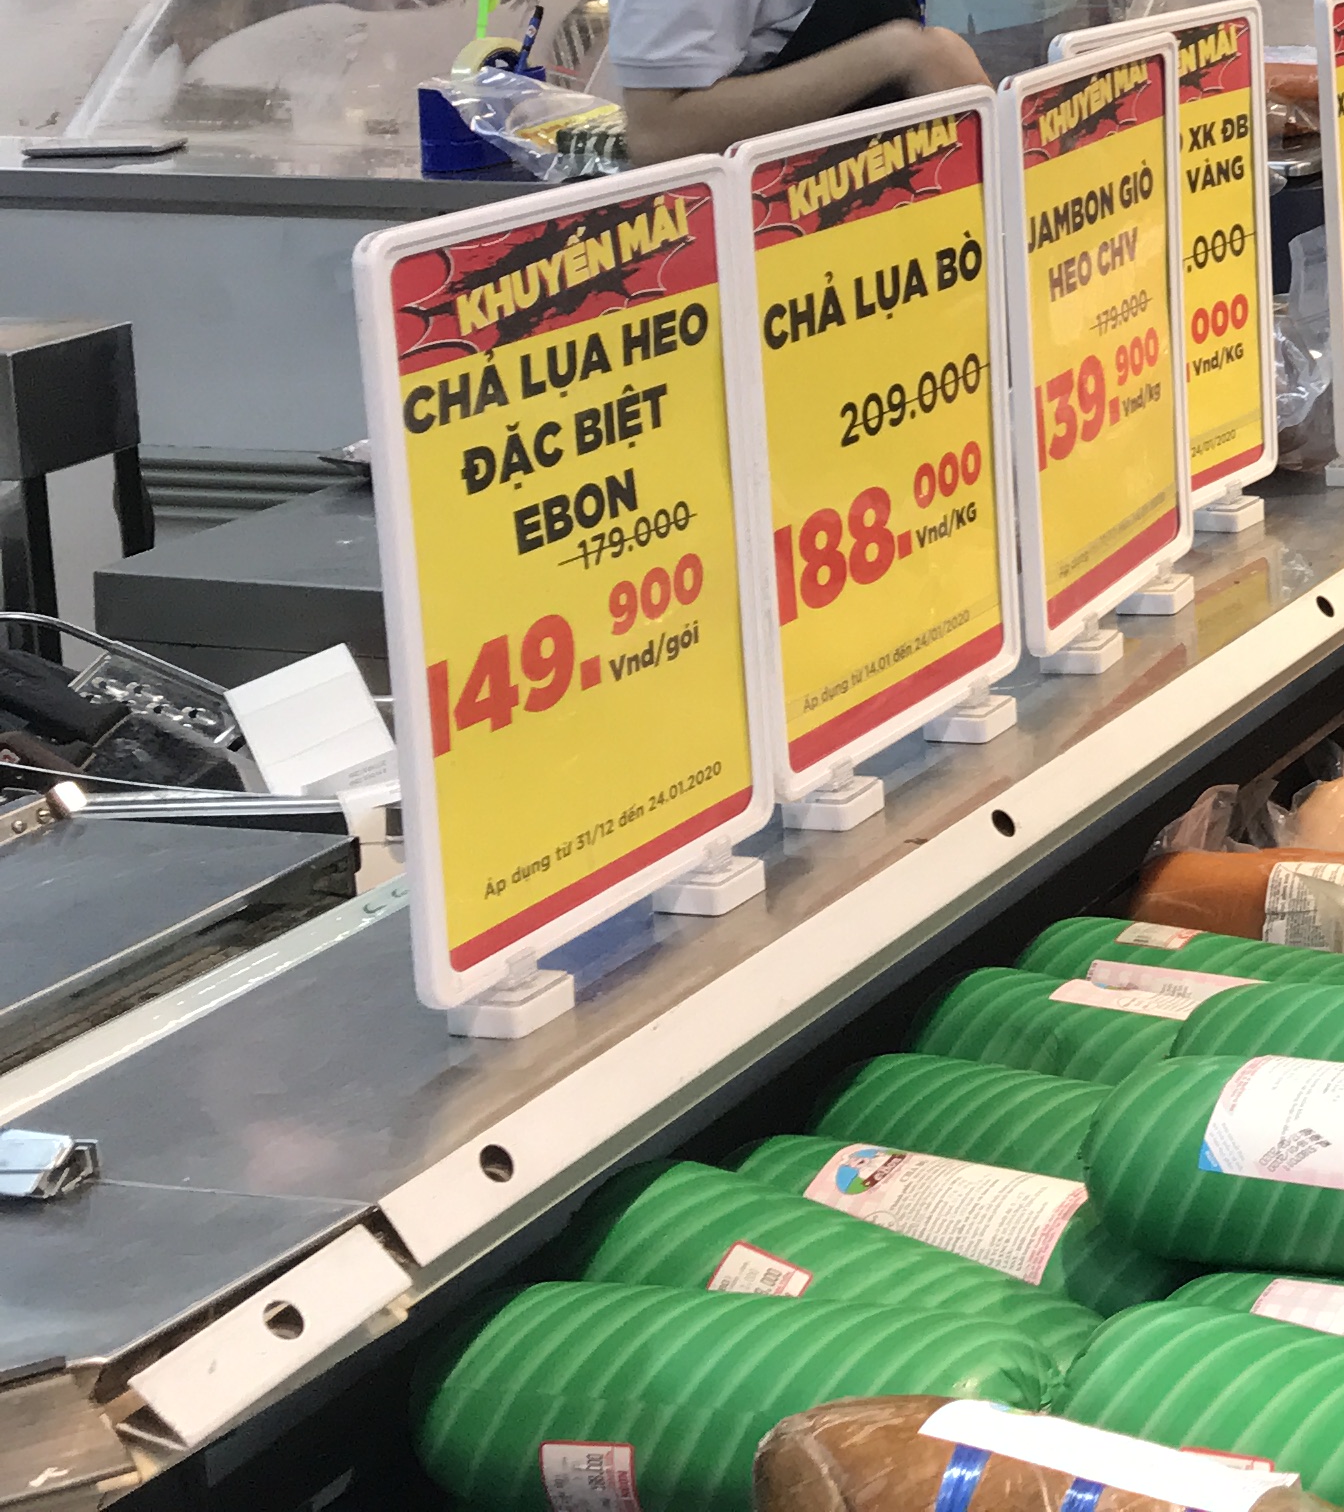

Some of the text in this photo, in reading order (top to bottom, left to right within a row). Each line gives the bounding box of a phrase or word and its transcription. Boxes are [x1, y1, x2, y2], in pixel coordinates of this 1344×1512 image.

[1039, 72, 1112, 147] KHUYẾN
[1188, 114, 1249, 153] XK ĐB
[789, 113, 960, 221] KHUYẾN MÃI
[1027, 160, 1154, 253] JAMBON GIÒ
[456, 195, 690, 336] KHUYẾN MÃI
[764, 231, 982, 350] CHẢ LỤA BÒ
[1048, 226, 1138, 301] HEO CHV
[1187, 224, 1245, 273] .000
[1094, 294, 1151, 336] 179.000
[1191, 294, 1249, 345] 000
[403, 302, 709, 434] CHẢ LỤA HEO
[839, 352, 986, 449] 209.000
[1035, 327, 1159, 472] 139. 900
[1192, 342, 1244, 376] Vnd/KG
[461, 382, 668, 496] ĐẶC BIỆT
[512, 469, 638, 555] EBON
[574, 500, 695, 569] 179.000
[774, 442, 982, 627] 188. 000
[916, 501, 979, 549] Vnd/KG
[427, 553, 704, 757] 149. 900
[608, 621, 700, 683] Vnd/gói
[914, 609, 971, 650] 24/01/2020
[484, 760, 722, 900] Áp dụng từ 31/12 đến 24.01.2020
